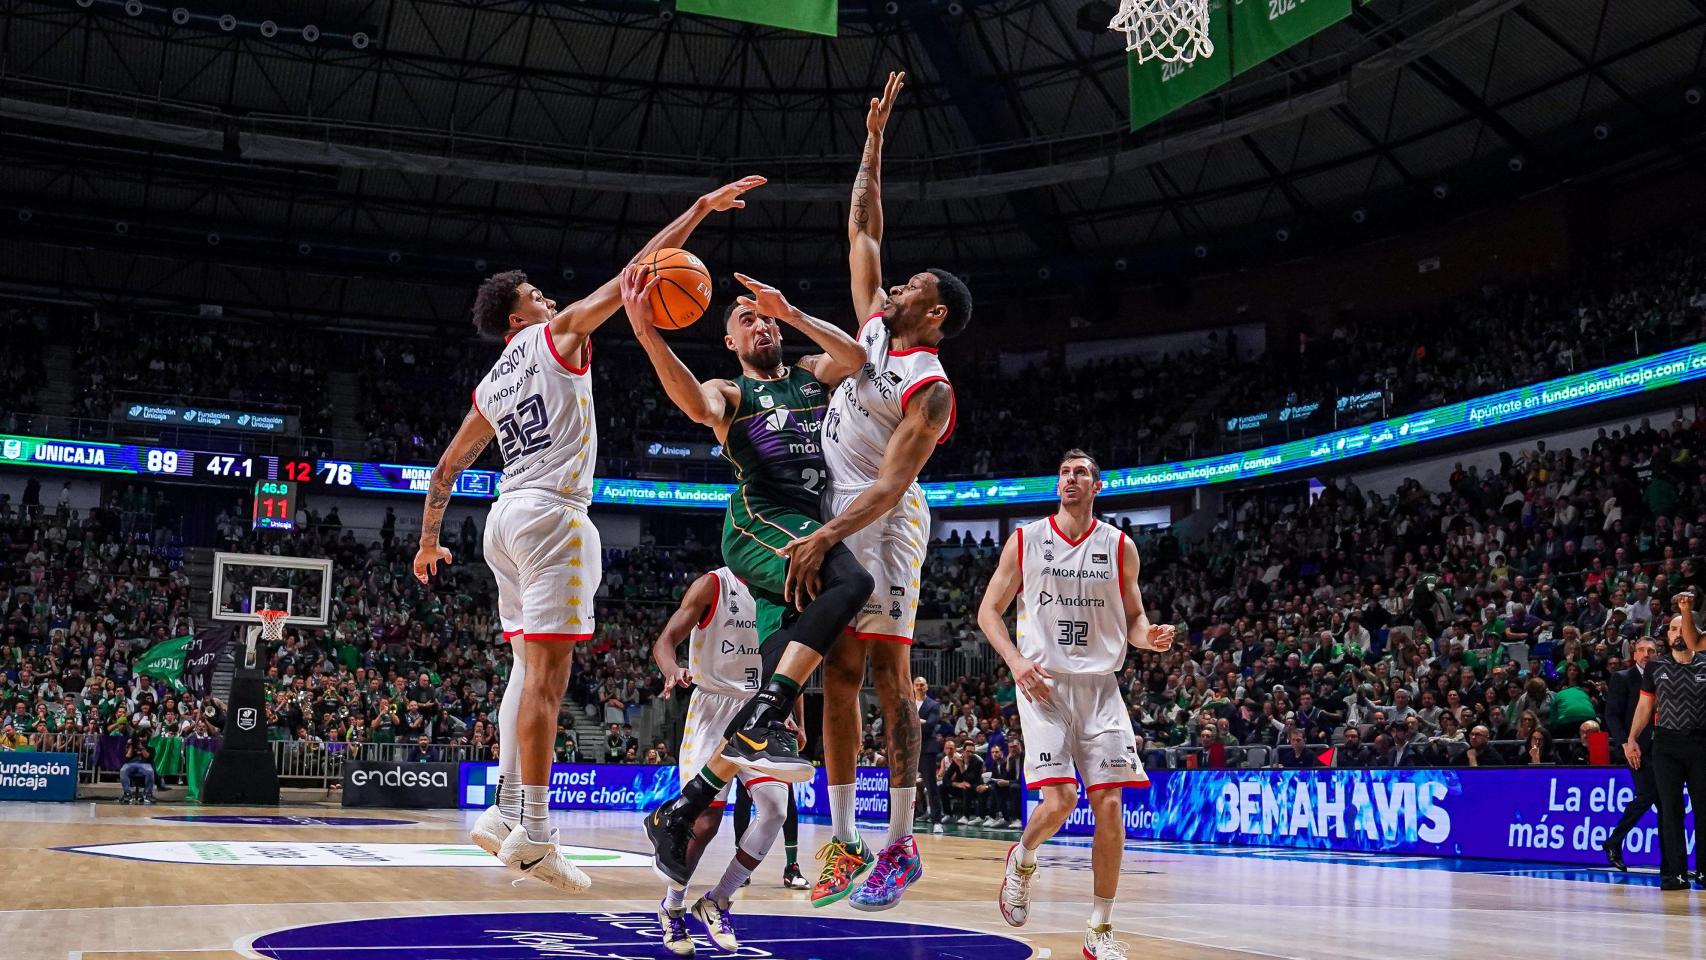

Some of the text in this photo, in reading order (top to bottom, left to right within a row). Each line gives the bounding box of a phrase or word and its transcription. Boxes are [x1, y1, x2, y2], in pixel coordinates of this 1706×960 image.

[1268, 0, 1305, 20] 202
[143, 406, 176, 416] Fundación
[143, 411, 167, 421] Unicaja
[198, 410, 230, 420] Fundación
[1469, 395, 1540, 421] Apúntate en
[198, 416, 221, 426] Unicaja
[251, 415, 283, 425] Fundación
[497, 393, 552, 469] 22
[35, 444, 105, 466] UNICAJA
[662, 446, 691, 457] Unicaja
[147, 450, 178, 473] 89
[206, 456, 253, 477] 47.1
[1126, 454, 1282, 486] fundacionunicaja.com/campus
[284, 462, 311, 482] 12
[324, 463, 353, 486] 76
[402, 467, 434, 480] MORA
[261, 483, 288, 495] 46.9
[1111, 478, 1125, 488] en
[603, 485, 656, 498] Apúntate
[658, 490, 673, 499] en
[263, 498, 288, 519] 11
[270, 520, 292, 530] Unicaja
[1051, 567, 1110, 579] MORABANC
[1055, 593, 1105, 608] Andorra
[1057, 620, 1089, 646] 32
[0, 762, 70, 776] undación
[351, 766, 448, 788] endesa
[552, 769, 597, 786] most
[1548, 778, 1582, 812] La
[1508, 814, 1565, 849] más
